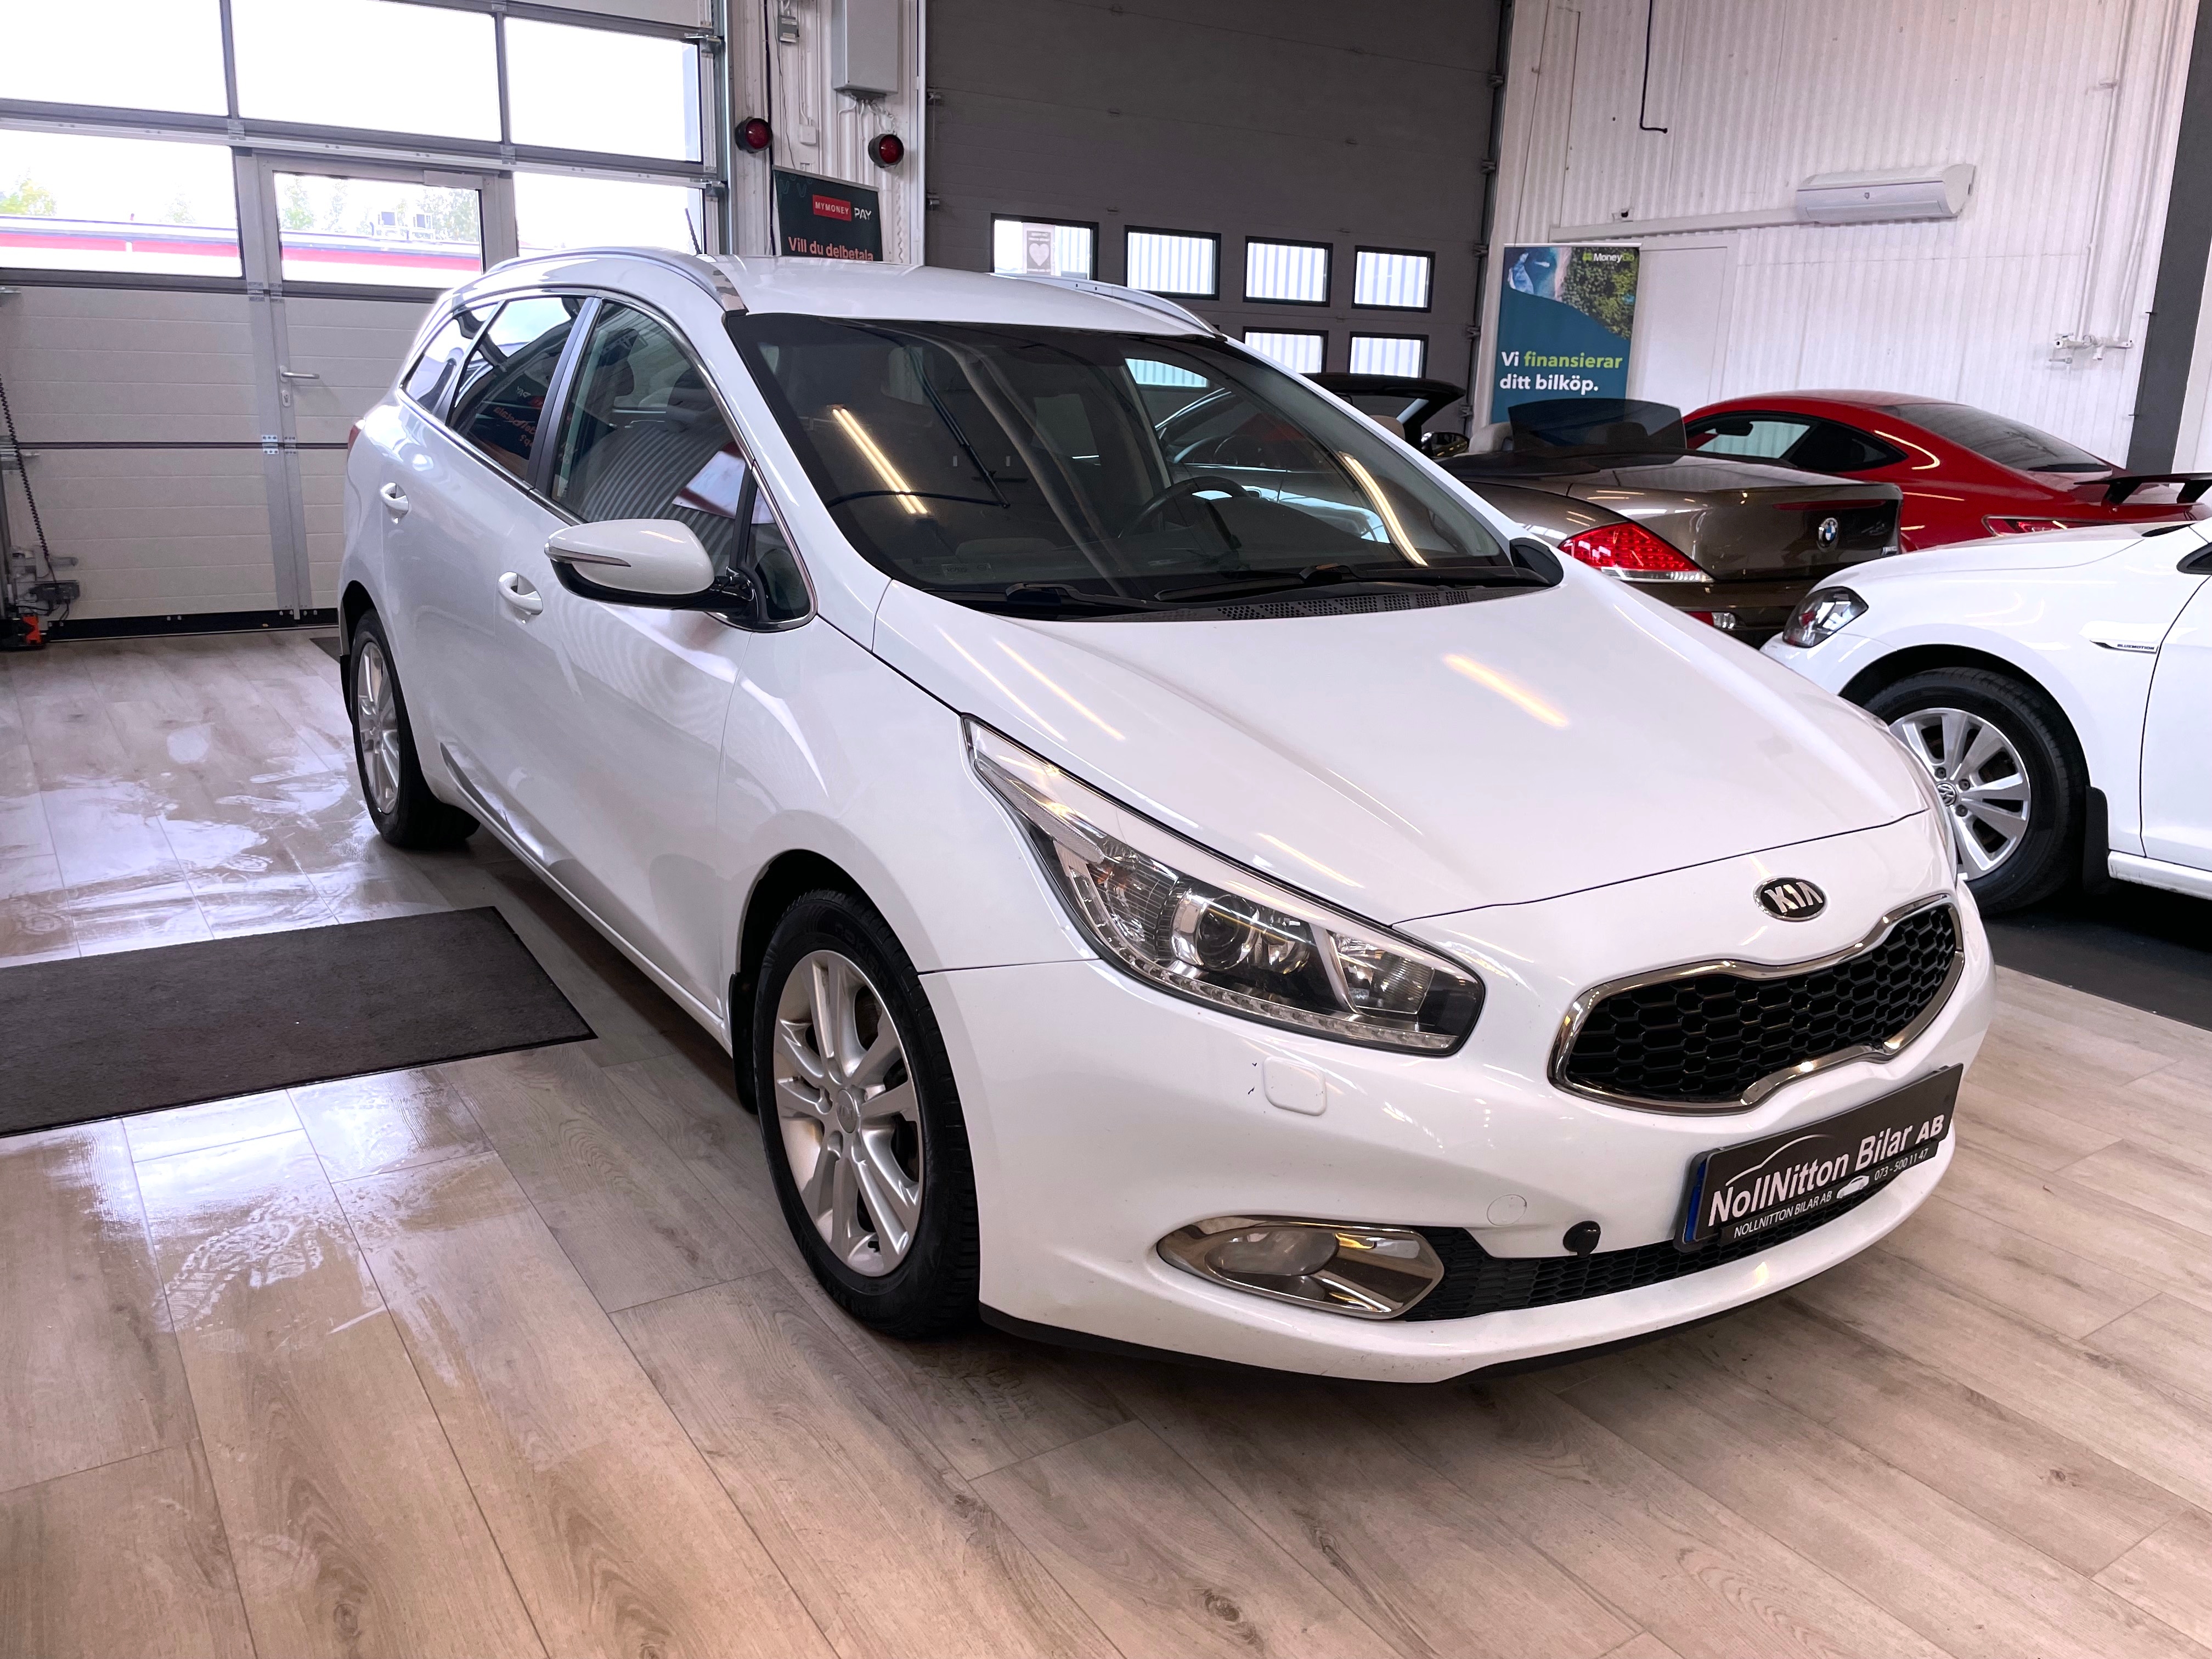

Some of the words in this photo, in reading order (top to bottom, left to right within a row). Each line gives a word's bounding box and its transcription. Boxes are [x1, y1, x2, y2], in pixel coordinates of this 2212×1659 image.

[815, 201, 849, 215] MYMONEY
[854, 207, 872, 221] PAY
[788, 236, 807, 253] Vill
[809, 240, 823, 256] du
[826, 242, 874, 261] delbetala
[1501, 351, 1519, 366] Vi
[1523, 351, 1623, 369] finansierar
[1499, 373, 1531, 390] ditt
[1535, 374, 1599, 396] bilköp.
[1763, 881, 1824, 913] KIA
[1708, 1153, 1849, 1227] NollNitton
[1855, 1124, 1914, 1170] Bilar
[1915, 1114, 1945, 1144] AB
[1734, 1205, 1794, 1239] NOLLNITTON
[1794, 1195, 1820, 1215] BILAR
[1819, 1190, 1833, 1205] AB
[1874, 1165, 1889, 1181] 073
[1893, 1156, 1909, 1173] 500
[1909, 1152, 1918, 1165] 11
[1918, 1147, 1929, 1160] 47
